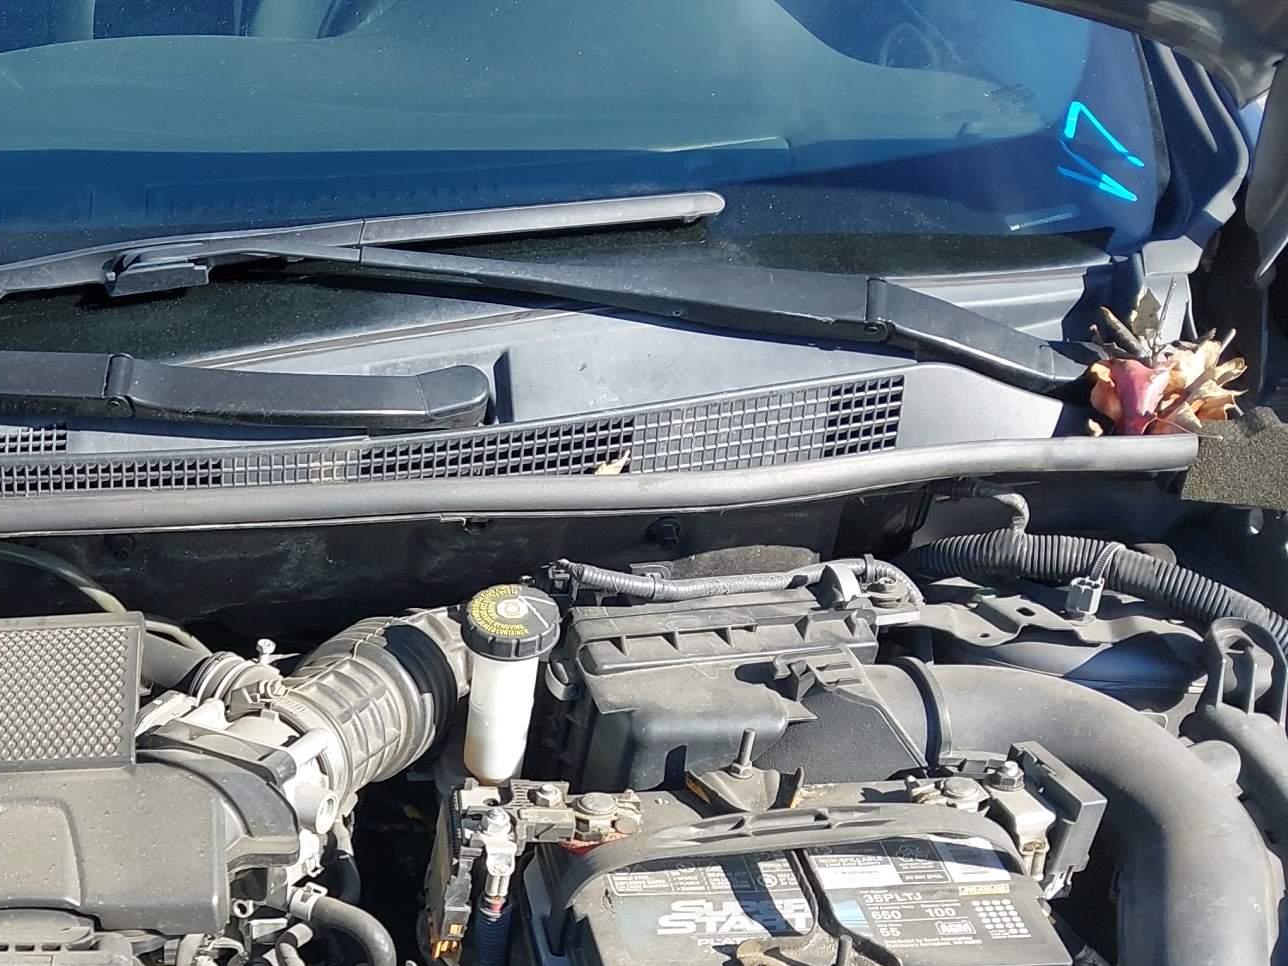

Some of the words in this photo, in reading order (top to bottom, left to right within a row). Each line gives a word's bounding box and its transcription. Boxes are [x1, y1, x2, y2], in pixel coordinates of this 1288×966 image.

[863, 892, 923, 903] 35PLTJ
[670, 898, 813, 918] SUPER
[925, 907, 956, 917] 100
[871, 910, 902, 920] 650
[657, 912, 813, 935] START
[879, 927, 901, 937] 55
